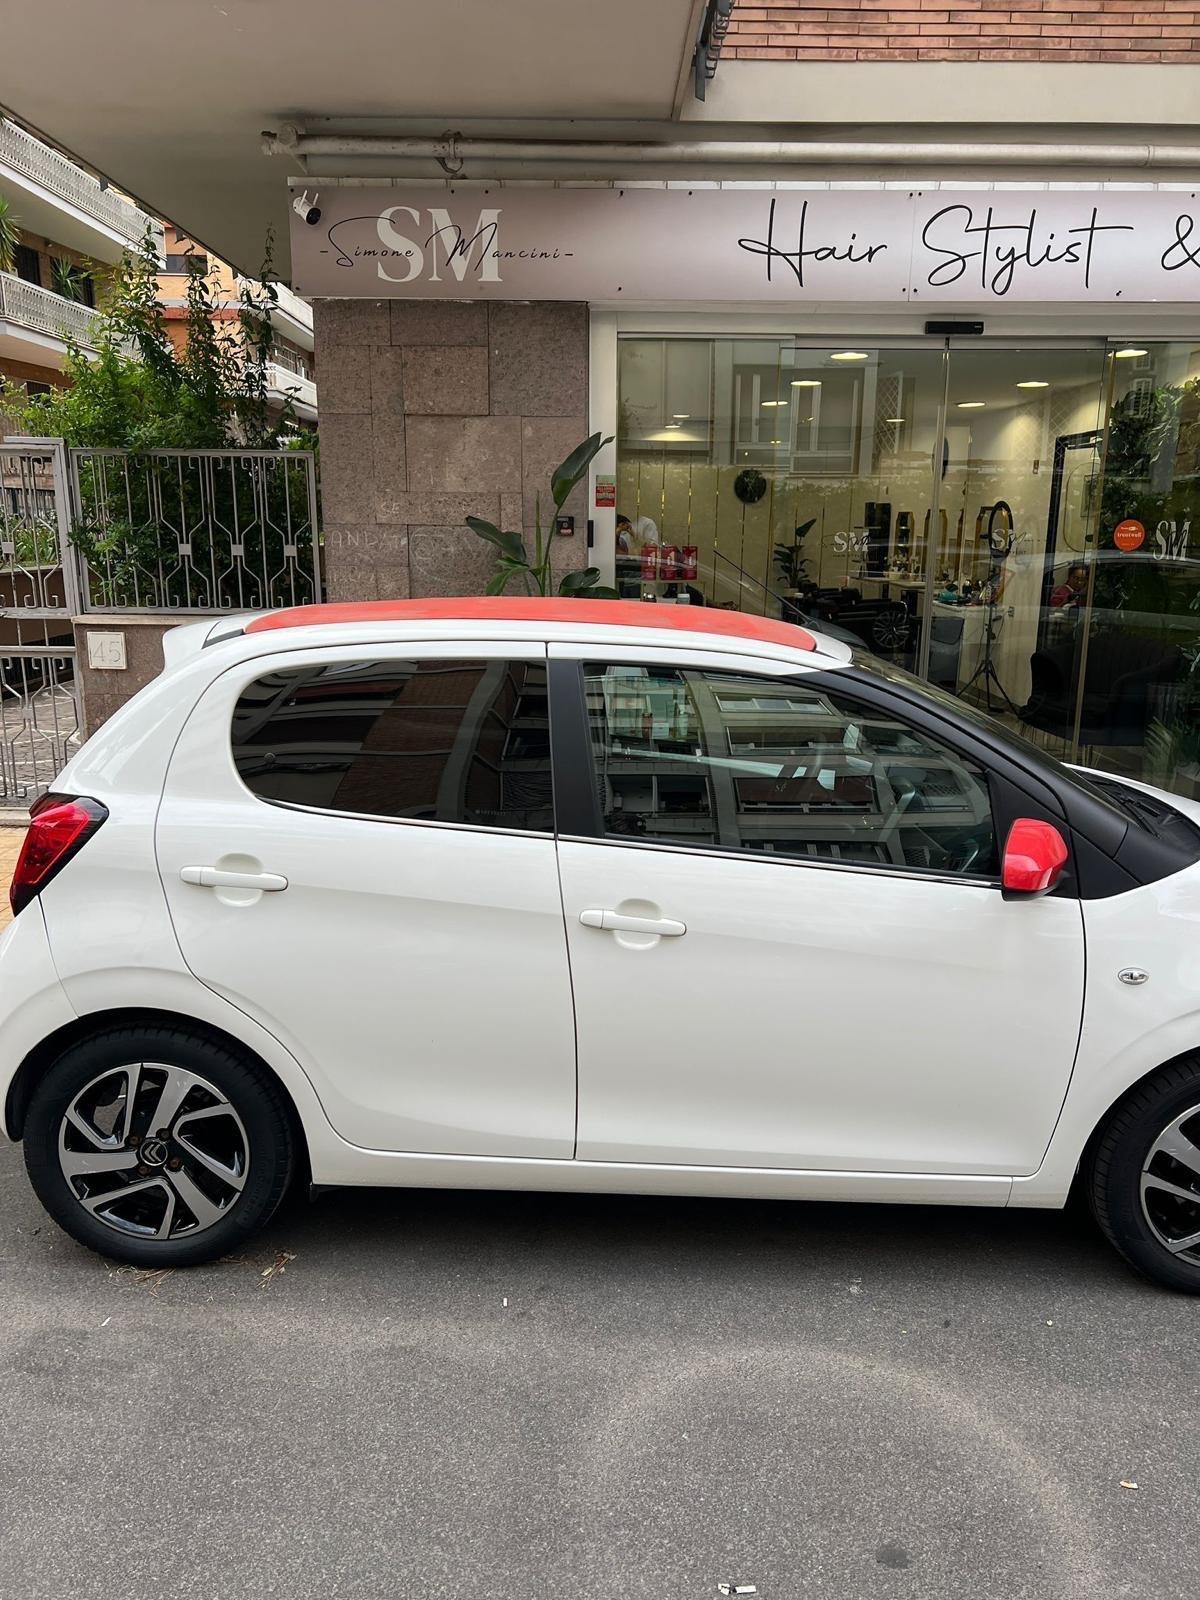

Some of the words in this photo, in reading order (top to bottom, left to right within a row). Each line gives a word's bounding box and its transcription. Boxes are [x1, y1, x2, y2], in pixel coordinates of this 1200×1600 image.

[376, 205, 503, 282] SM
[737, 198, 887, 287] Hair
[921, 204, 1134, 295] Stylist
[1161, 213, 1200, 270] &
[1153, 520, 1191, 560] SM
[93, 640, 121, 662] 45
